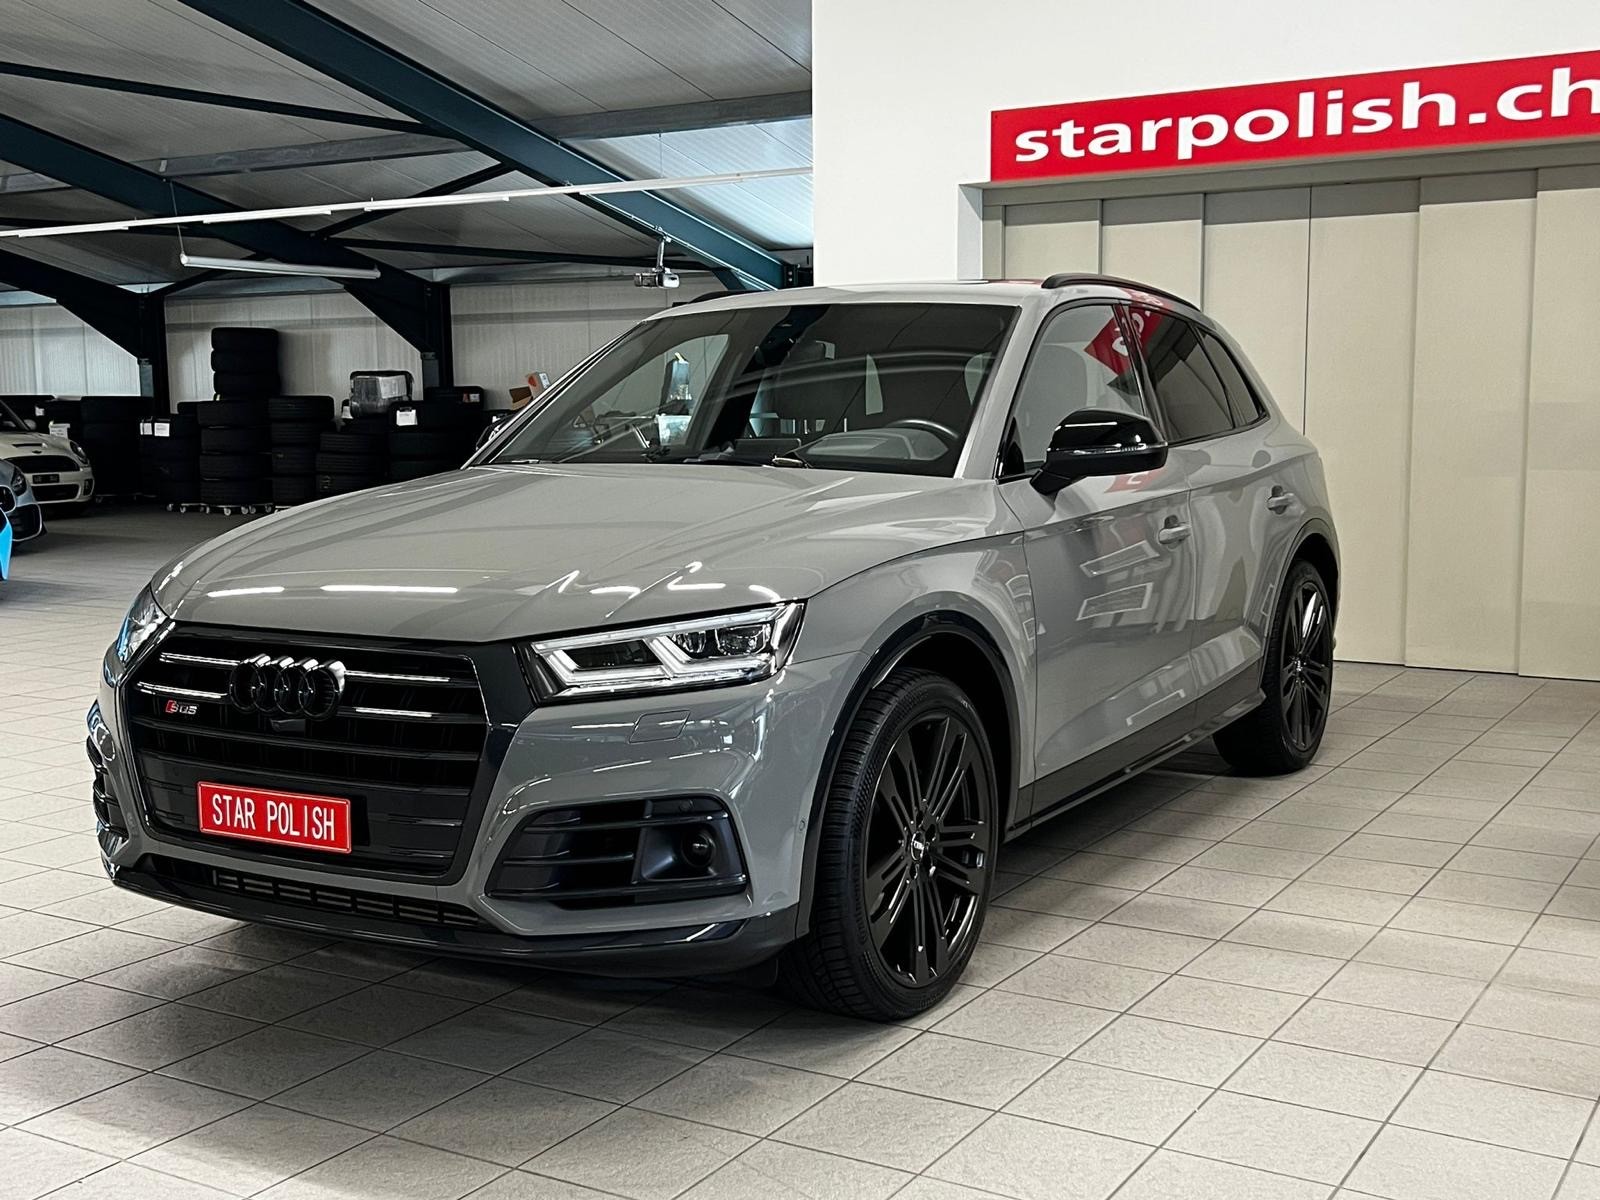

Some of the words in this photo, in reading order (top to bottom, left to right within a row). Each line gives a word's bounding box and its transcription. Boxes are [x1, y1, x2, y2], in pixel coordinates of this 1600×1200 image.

[1015, 67, 1600, 162] starpolish.ch
[165, 699, 198, 715] SQ5
[212, 793, 256, 831] STAR
[266, 799, 335, 841] POLISH
